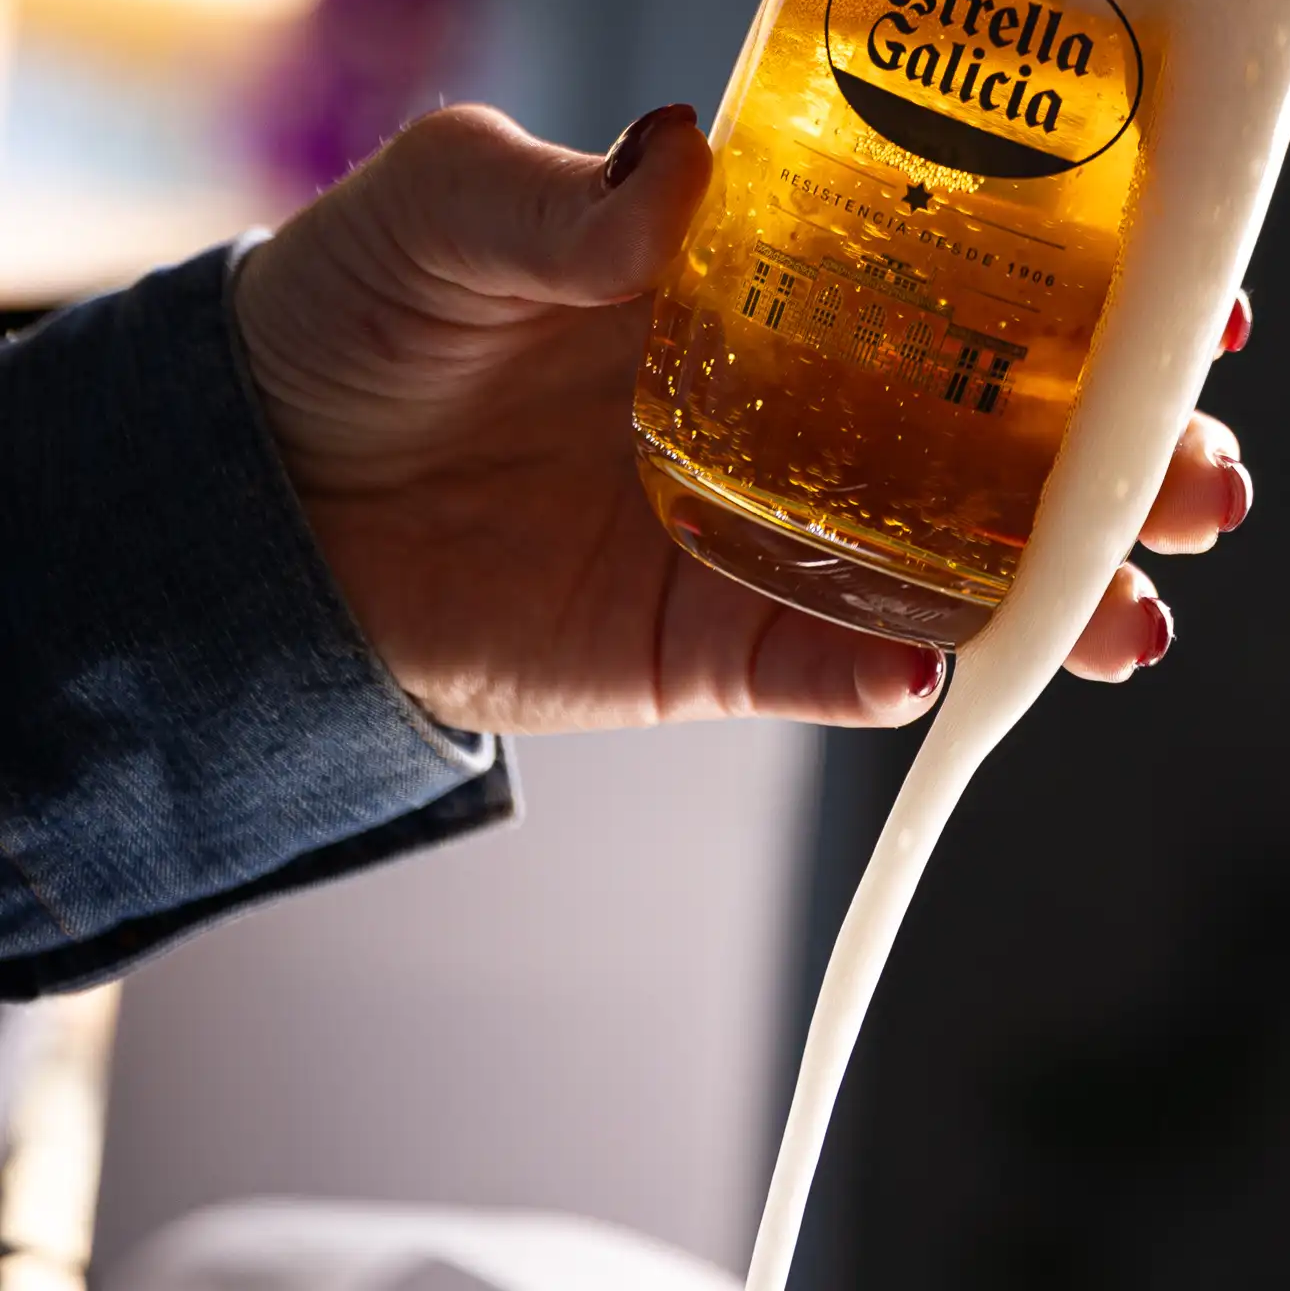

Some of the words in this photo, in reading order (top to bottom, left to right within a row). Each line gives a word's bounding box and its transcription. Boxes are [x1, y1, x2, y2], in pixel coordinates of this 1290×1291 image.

[867, 11, 1063, 133] Galicia
[780, 168, 907, 236] RESISTENCIA
[920, 229, 994, 267] DESDE
[1008, 262, 1055, 287] 1906
